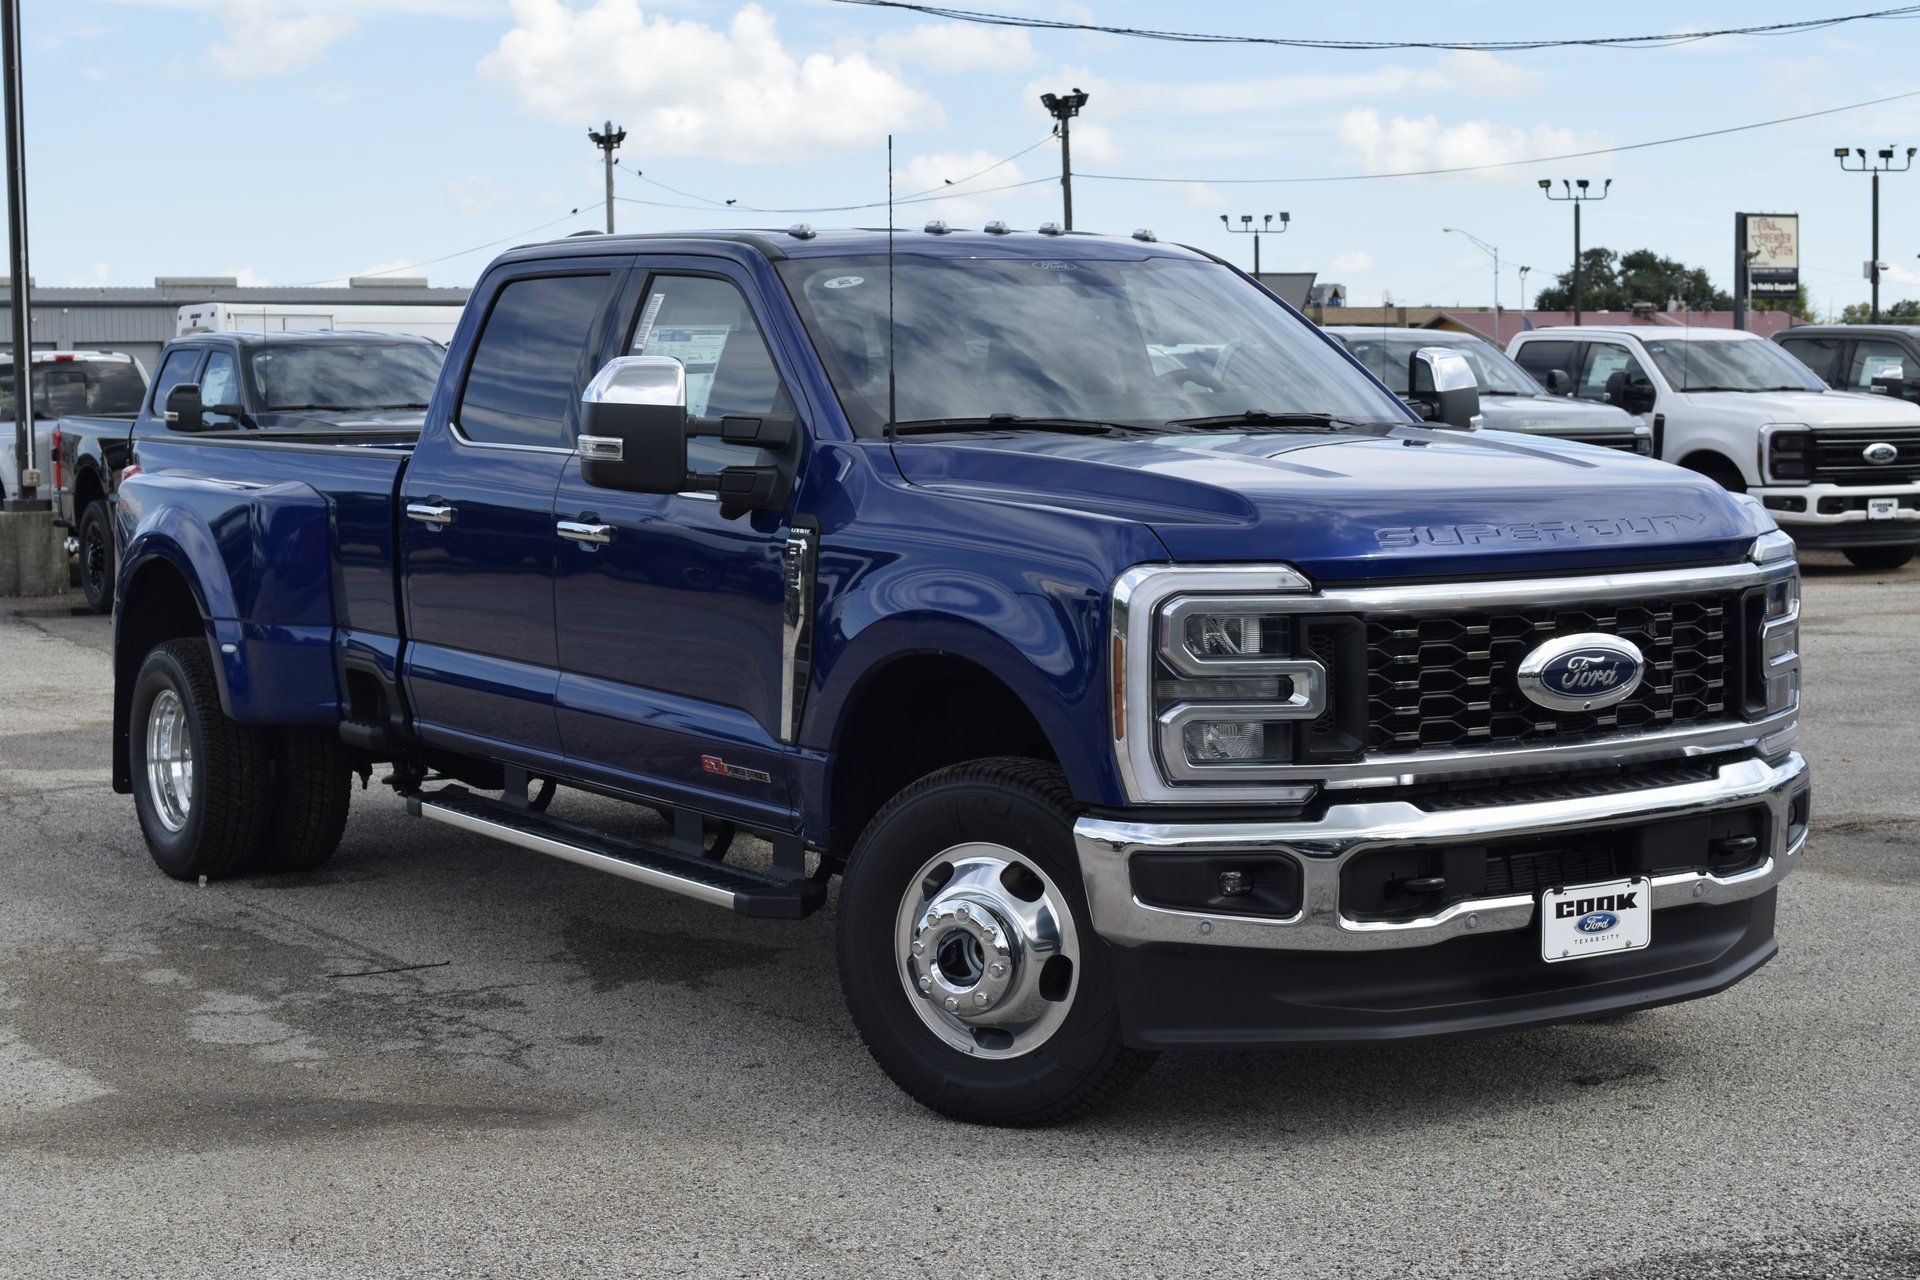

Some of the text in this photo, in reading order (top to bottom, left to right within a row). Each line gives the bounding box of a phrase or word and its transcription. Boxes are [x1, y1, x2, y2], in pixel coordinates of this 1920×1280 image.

[1374, 512, 1706, 548] SUPER DUTY
[1562, 655, 1620, 690] Ford
[1555, 892, 1638, 919] COOK
[1584, 915, 1610, 931] Ford
[1574, 934, 1619, 945] TEXAS CITY
